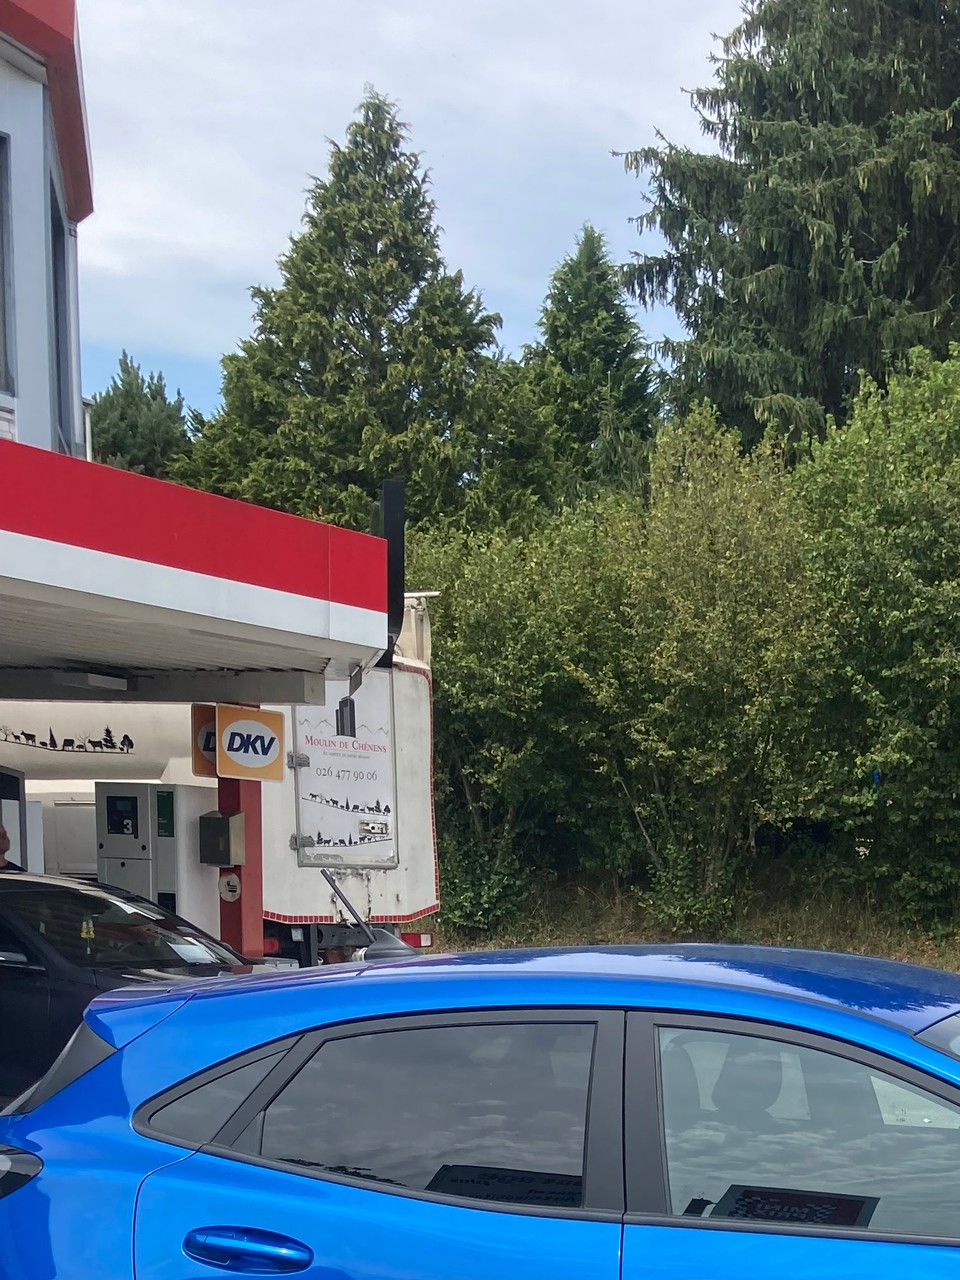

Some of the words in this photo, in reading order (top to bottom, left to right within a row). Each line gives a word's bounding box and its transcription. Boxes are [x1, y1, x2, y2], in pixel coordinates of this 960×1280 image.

[227, 732, 276, 756] DKV
[305, 735, 336, 748] MOULIN
[340, 741, 349, 749] DE
[316, 766, 333, 777] 026
[336, 769, 351, 781] 477
[353, 770, 364, 782] 90
[366, 770, 378, 781] 06
[123, 819, 133, 834] 3
